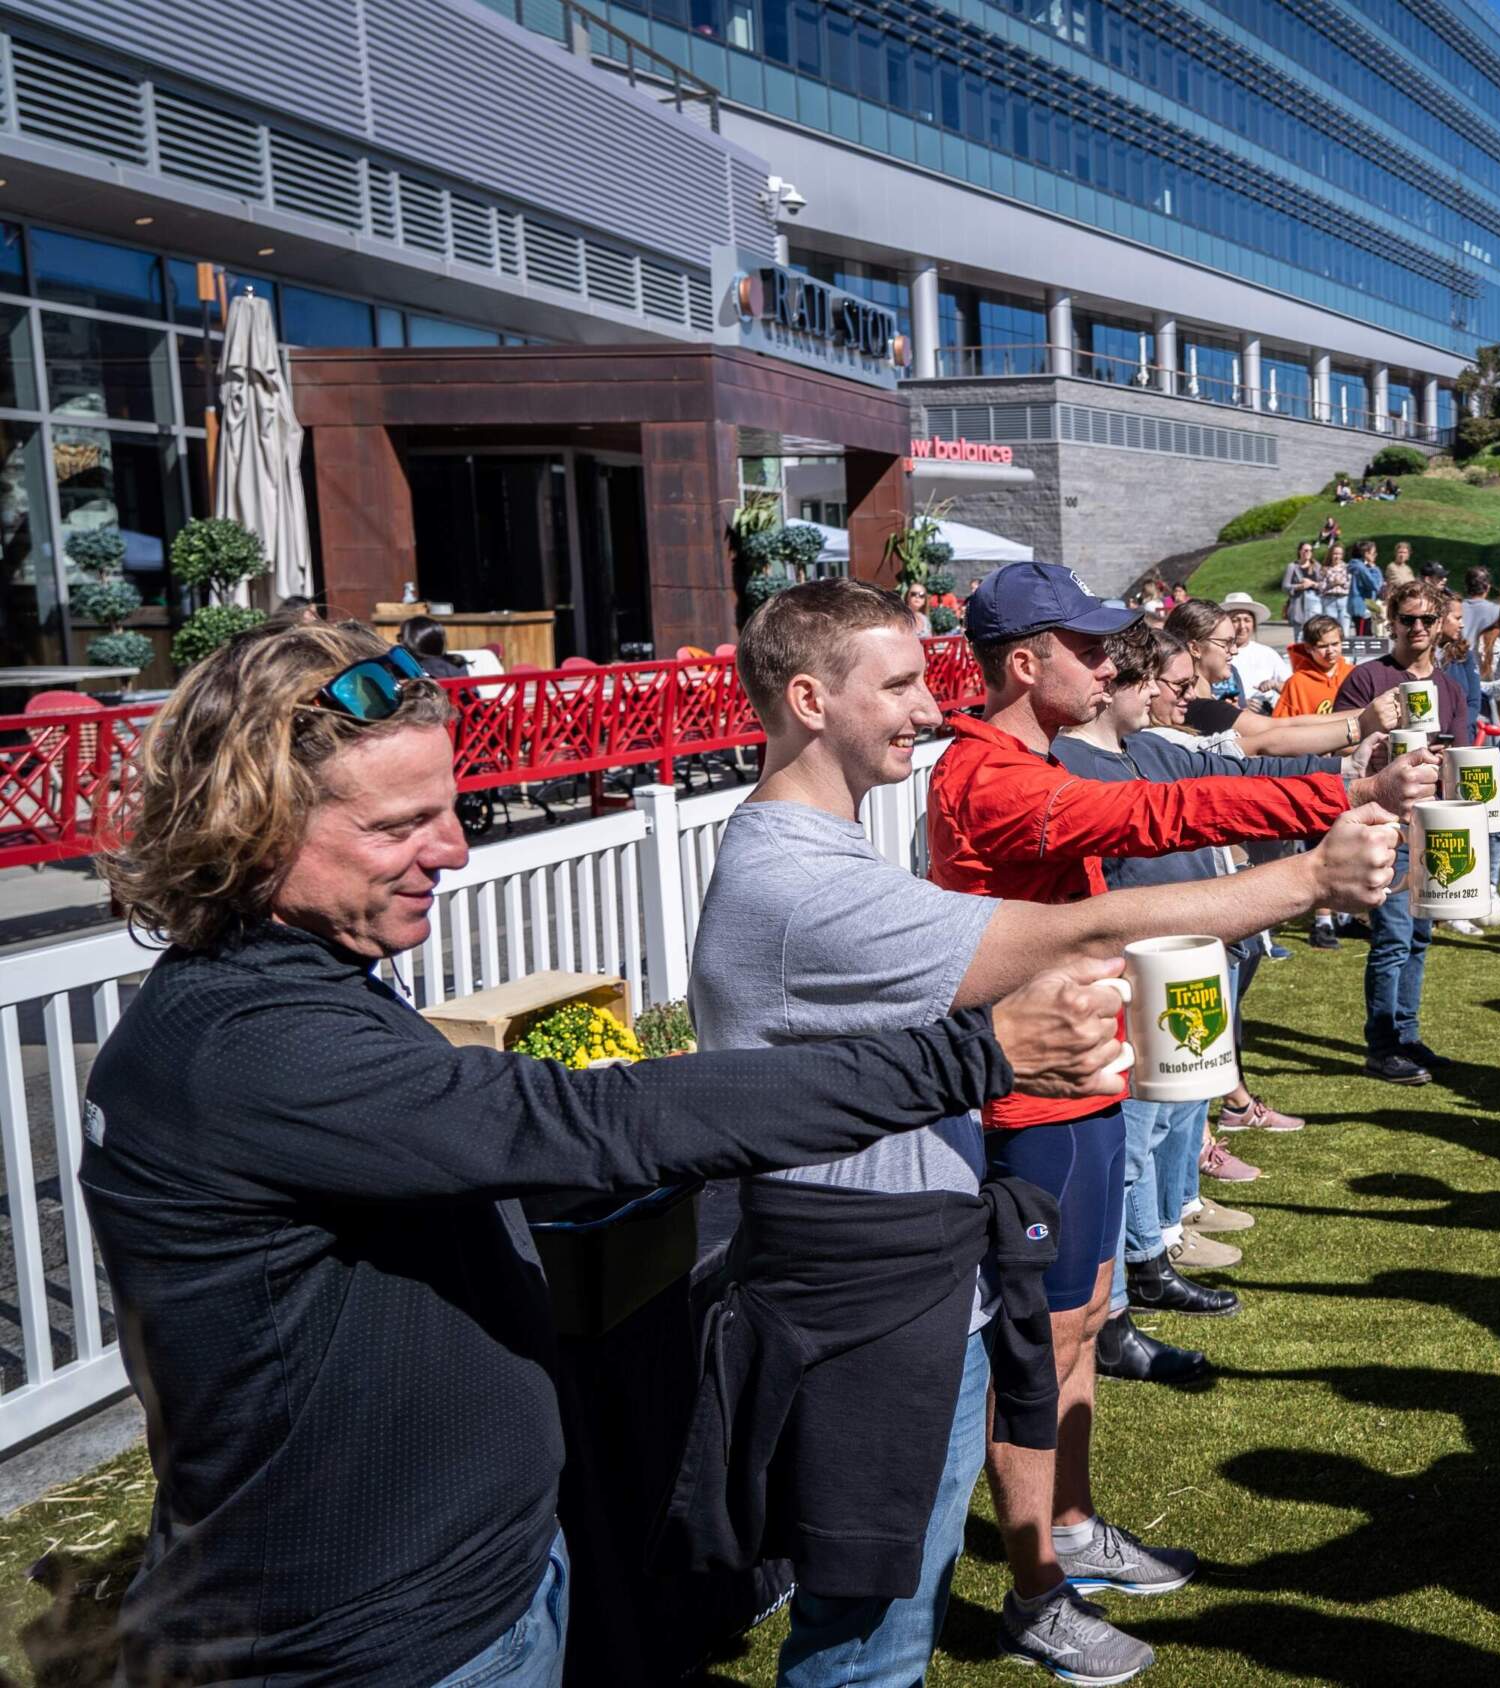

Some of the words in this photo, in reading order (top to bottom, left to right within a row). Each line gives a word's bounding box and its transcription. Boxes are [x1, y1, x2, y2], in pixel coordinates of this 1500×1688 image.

[766, 268, 836, 341] RAIL
[843, 299, 894, 358] STOP
[934, 435, 1012, 463] balance
[1462, 770, 1489, 784] Trapp
[1428, 834, 1465, 853] Trapp
[1462, 888, 1479, 898] 2022
[1171, 987, 1217, 1009] Trapp
[1159, 1058, 1218, 1074] Oktoberfest
[1219, 1050, 1232, 1066] 2022
